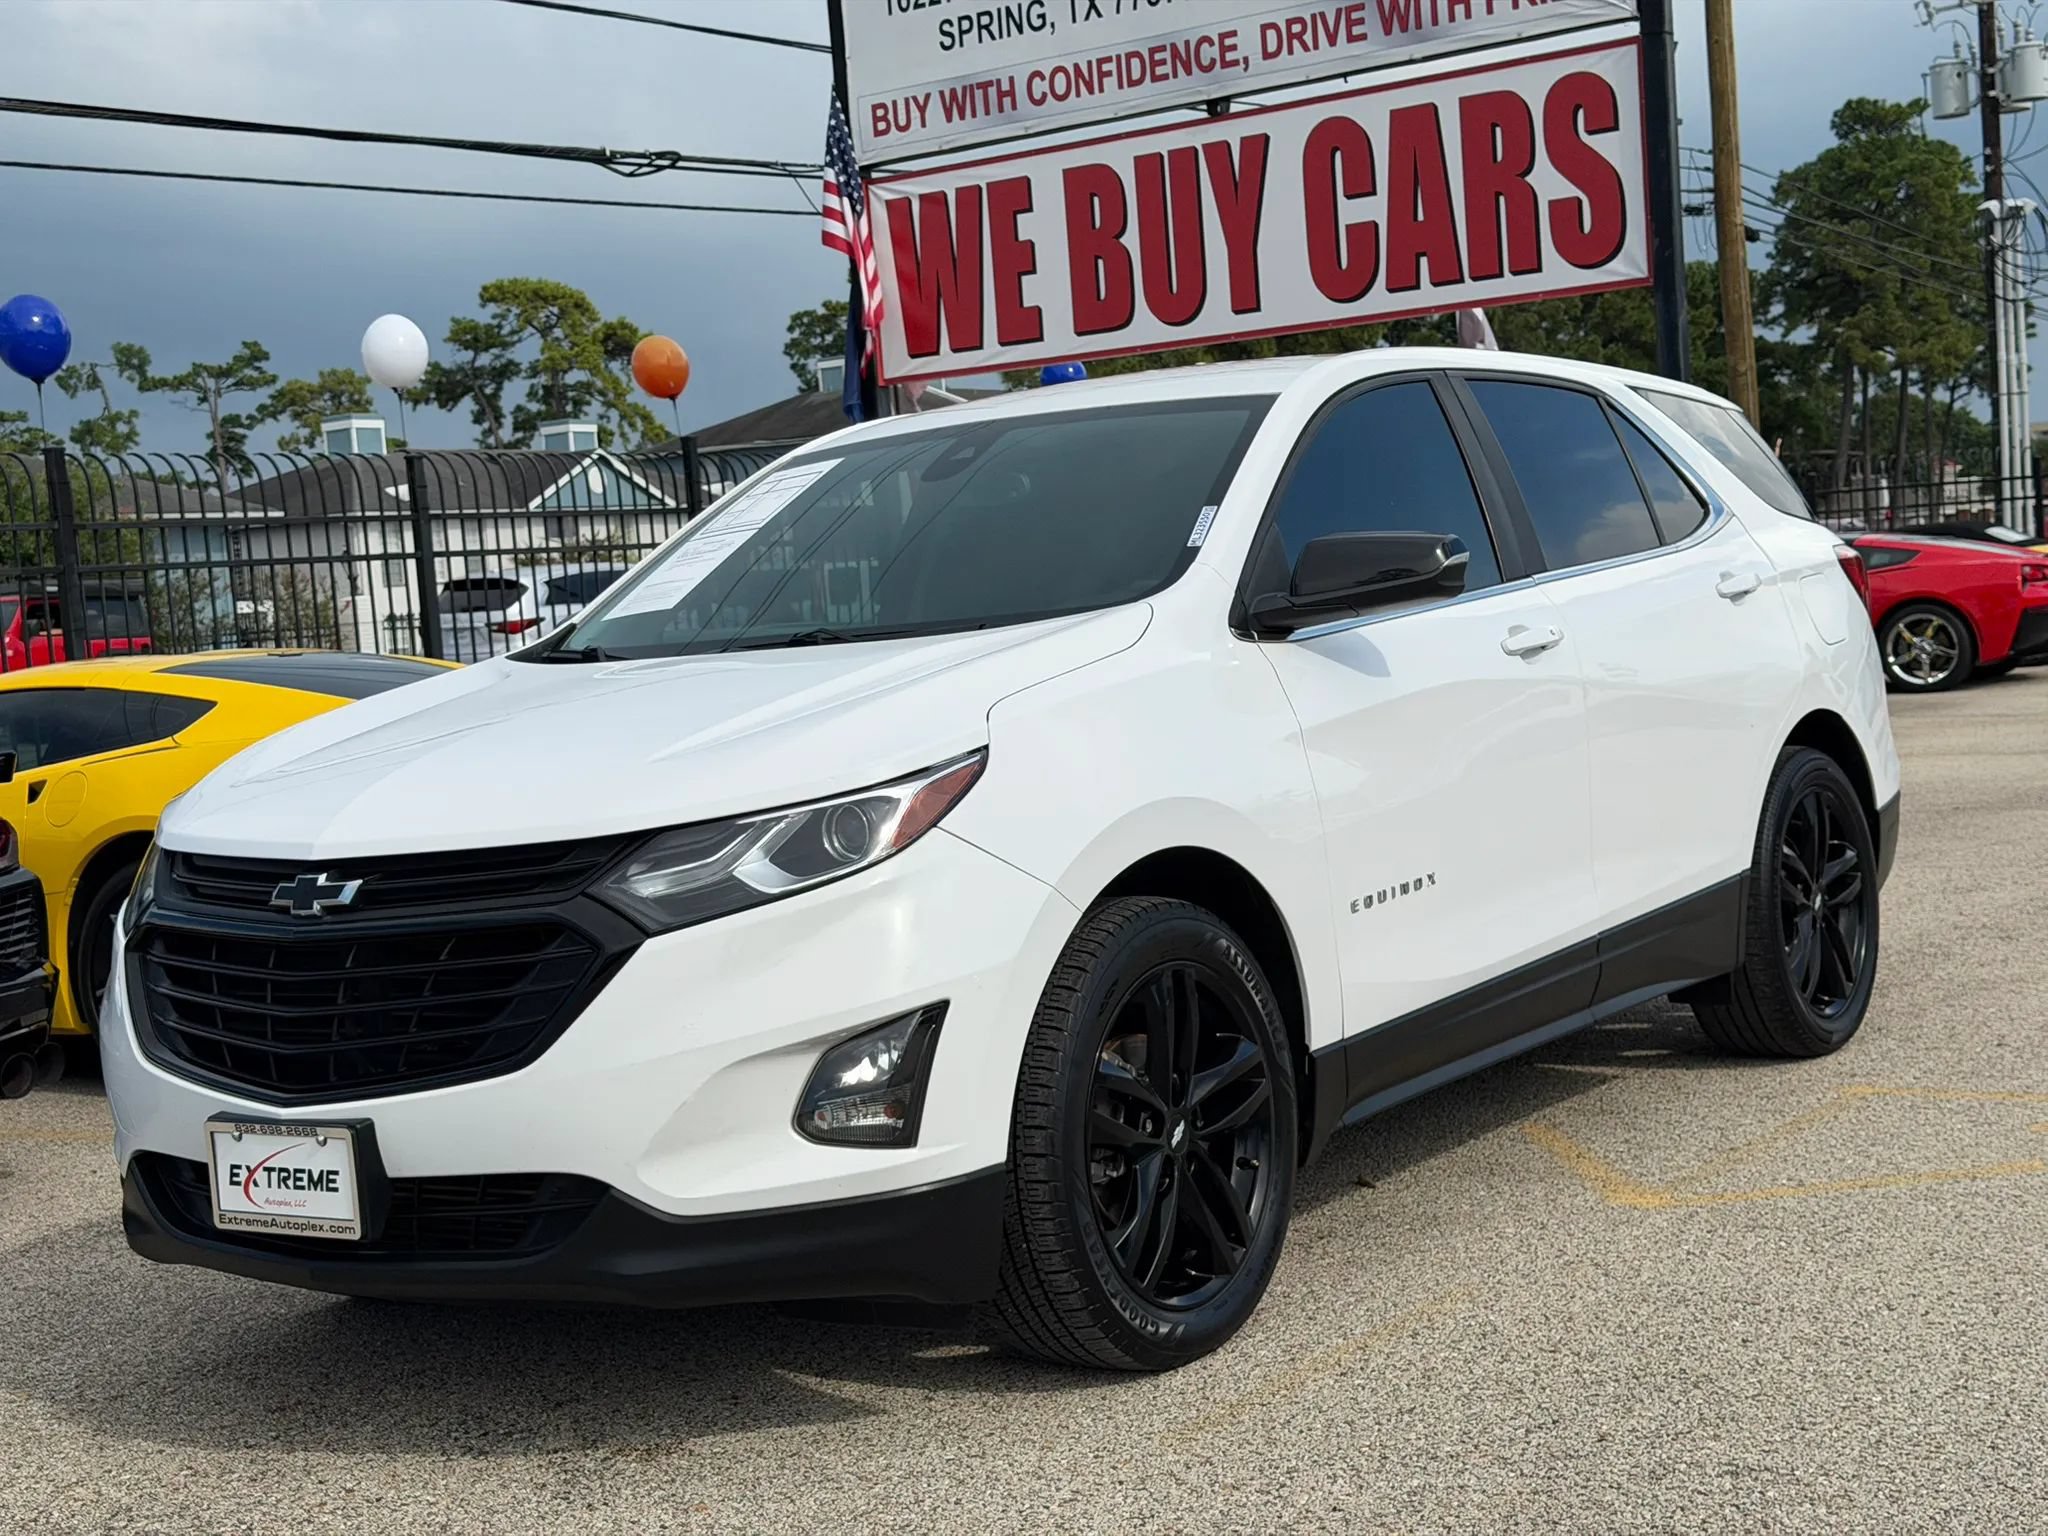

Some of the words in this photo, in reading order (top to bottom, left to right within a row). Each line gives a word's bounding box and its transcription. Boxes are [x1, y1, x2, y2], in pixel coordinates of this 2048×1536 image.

[938, 0, 1056, 51] SPRING,
[871, 93, 931, 137] BUY
[939, 76, 1018, 122] WITH
[1026, 30, 1249, 106] CONFIDENCE,
[1260, 3, 1368, 61] DRIVE
[1376, 0, 1472, 37] WITH
[886, 175, 1044, 359] WE
[1062, 133, 1270, 336] BUY
[1303, 71, 1627, 303] CARS
[1350, 872, 1436, 914] EQUINOX
[1222, 944, 1288, 1053] ASSURANCE
[229, 1164, 340, 1192] EXTREME
[219, 1214, 356, 1234] ExtremeAutoplex.com
